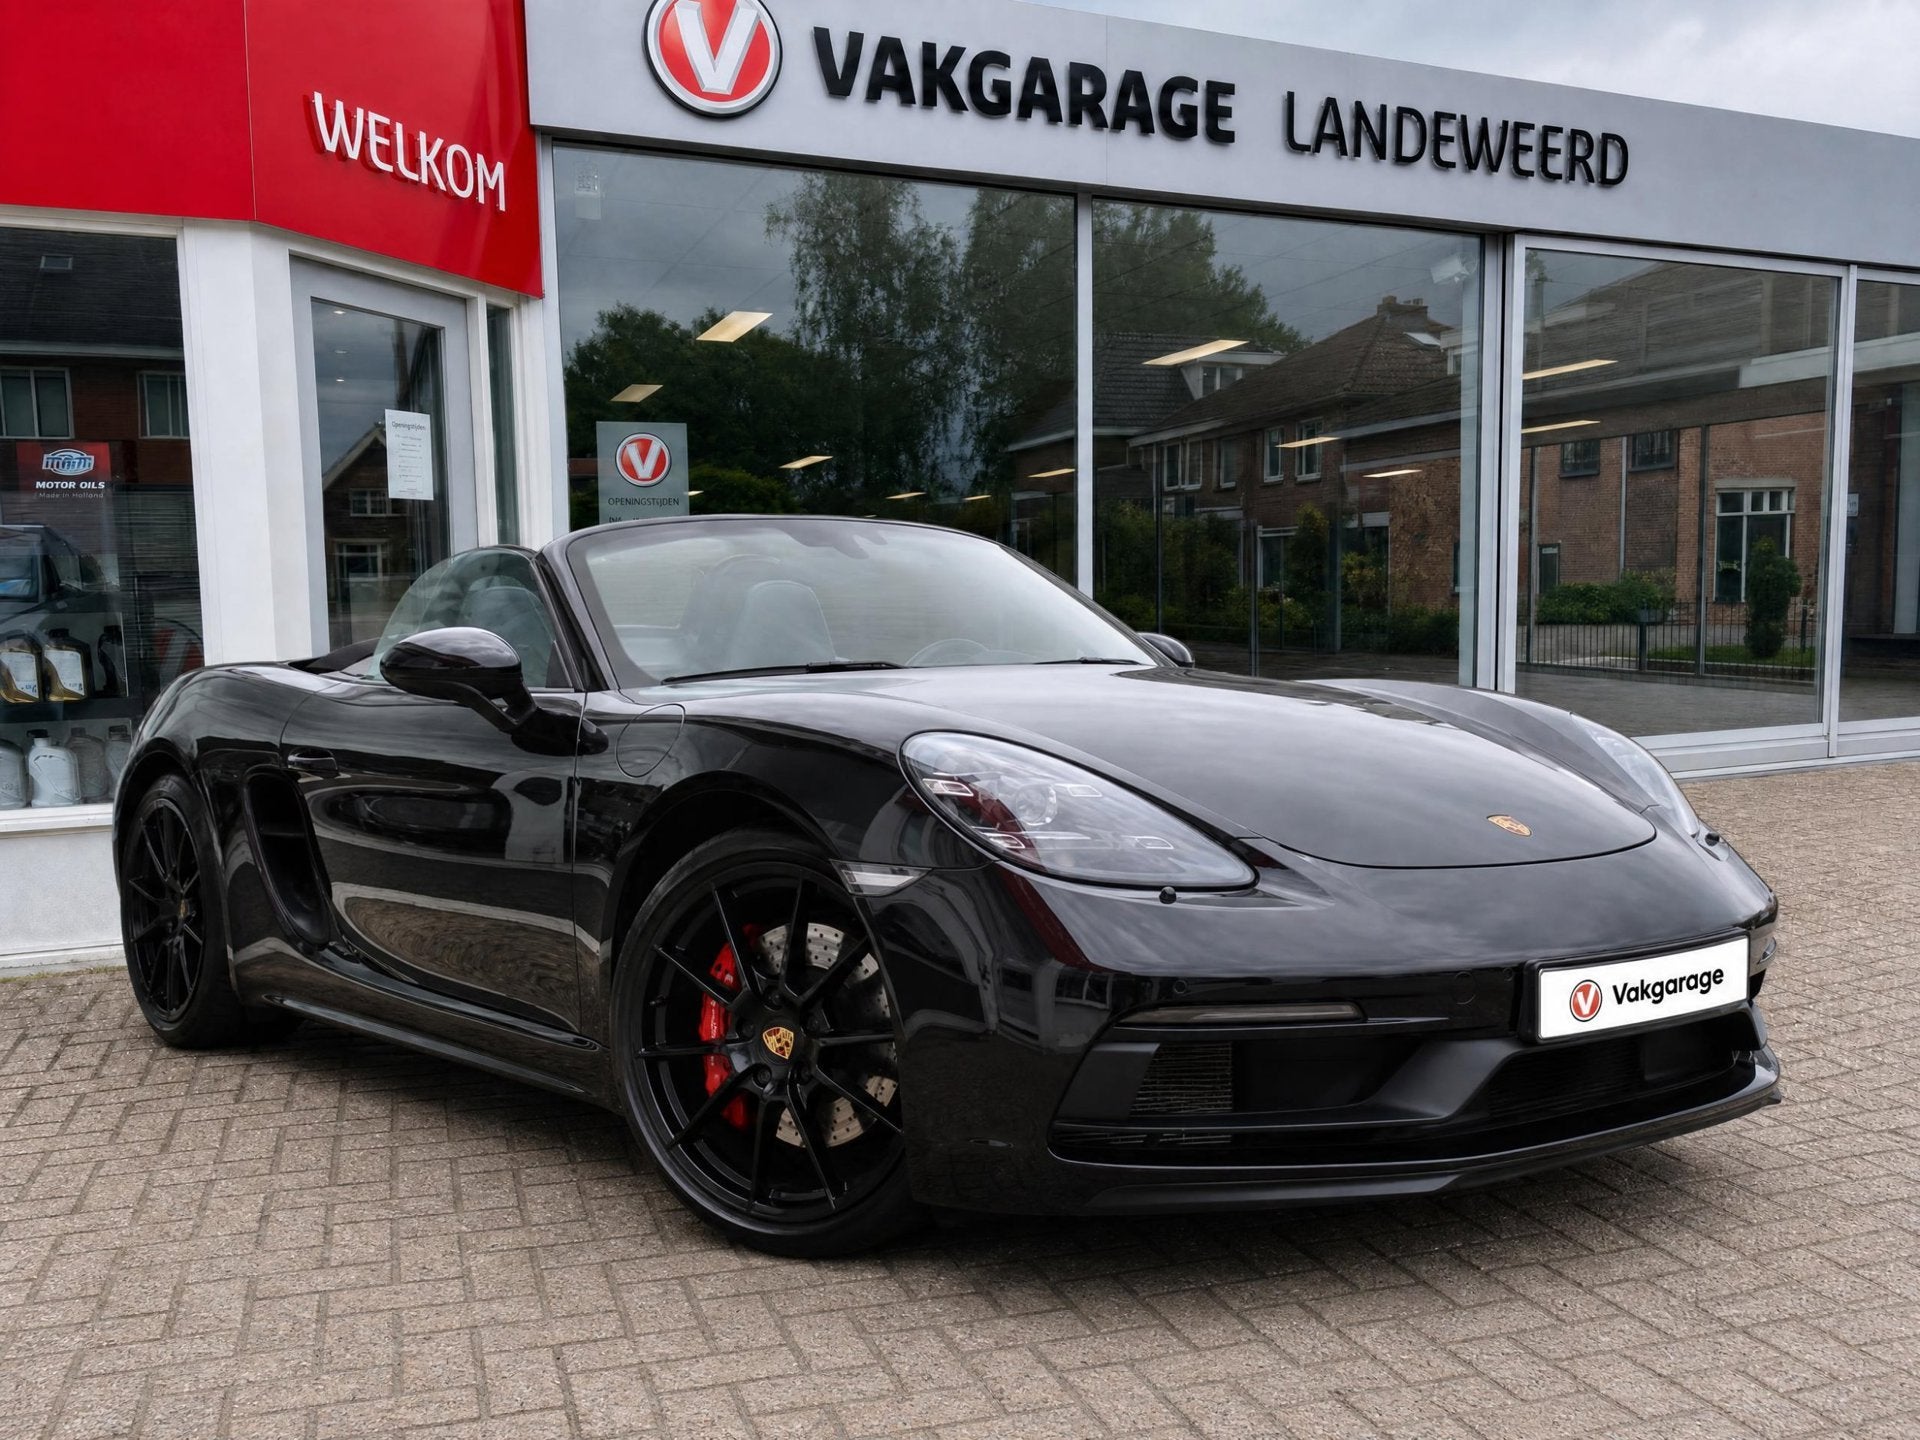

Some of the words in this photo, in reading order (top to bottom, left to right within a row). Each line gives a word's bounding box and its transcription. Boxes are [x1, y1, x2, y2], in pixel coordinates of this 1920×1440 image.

[674, 0, 760, 95] V
[813, 26, 1235, 144] VAKGARAGE
[1285, 91, 1629, 186] LANDEWEERD
[313, 91, 506, 212] WELKOM
[392, 421, 426, 432] Openingstijden
[36, 481, 76, 489] MOTOR
[80, 481, 106, 489] OILS
[608, 497, 680, 507] OPENINGSTIJDEN
[1612, 968, 1725, 1005] Vakgarage
